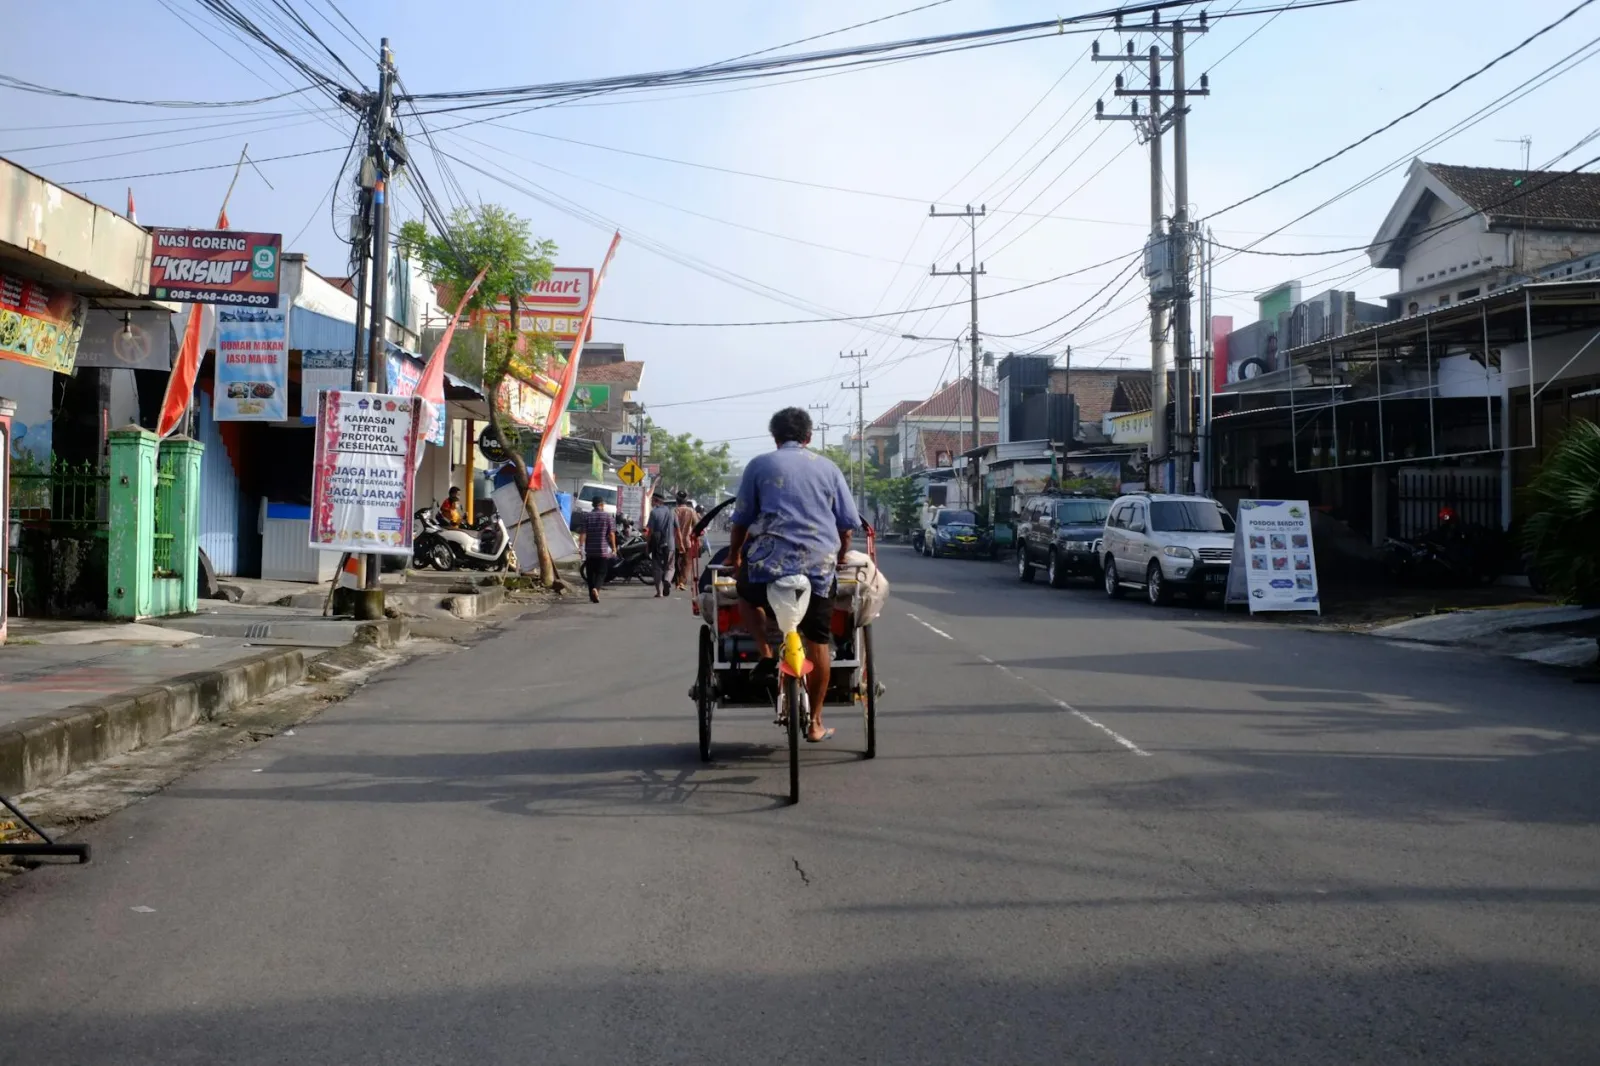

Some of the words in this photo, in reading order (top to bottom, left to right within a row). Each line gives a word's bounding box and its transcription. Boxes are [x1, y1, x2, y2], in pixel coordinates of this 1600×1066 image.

[158, 234, 189, 247] NASI
[192, 236, 246, 251] GORENG
[252, 270, 275, 279] Grab
[170, 289, 270, 305] 085-648-403-030
[220, 340, 252, 351] RUMAH
[253, 340, 284, 351] MAKAN
[226, 354, 247, 364] JASO
[248, 354, 278, 364] MANDE
[344, 414, 395, 425] KAWASAN
[351, 424, 387, 434] TERTIB
[341, 432, 396, 443] PROTOKOL
[338, 441, 398, 453] KESEHATAN
[334, 466, 366, 477] JAGA
[370, 468, 398, 479] HATI
[355, 478, 404, 487] KESAYANGAN
[326, 487, 358, 497] JAGA
[362, 489, 404, 500] JARAK
[356, 499, 400, 508] KESEHATAN
